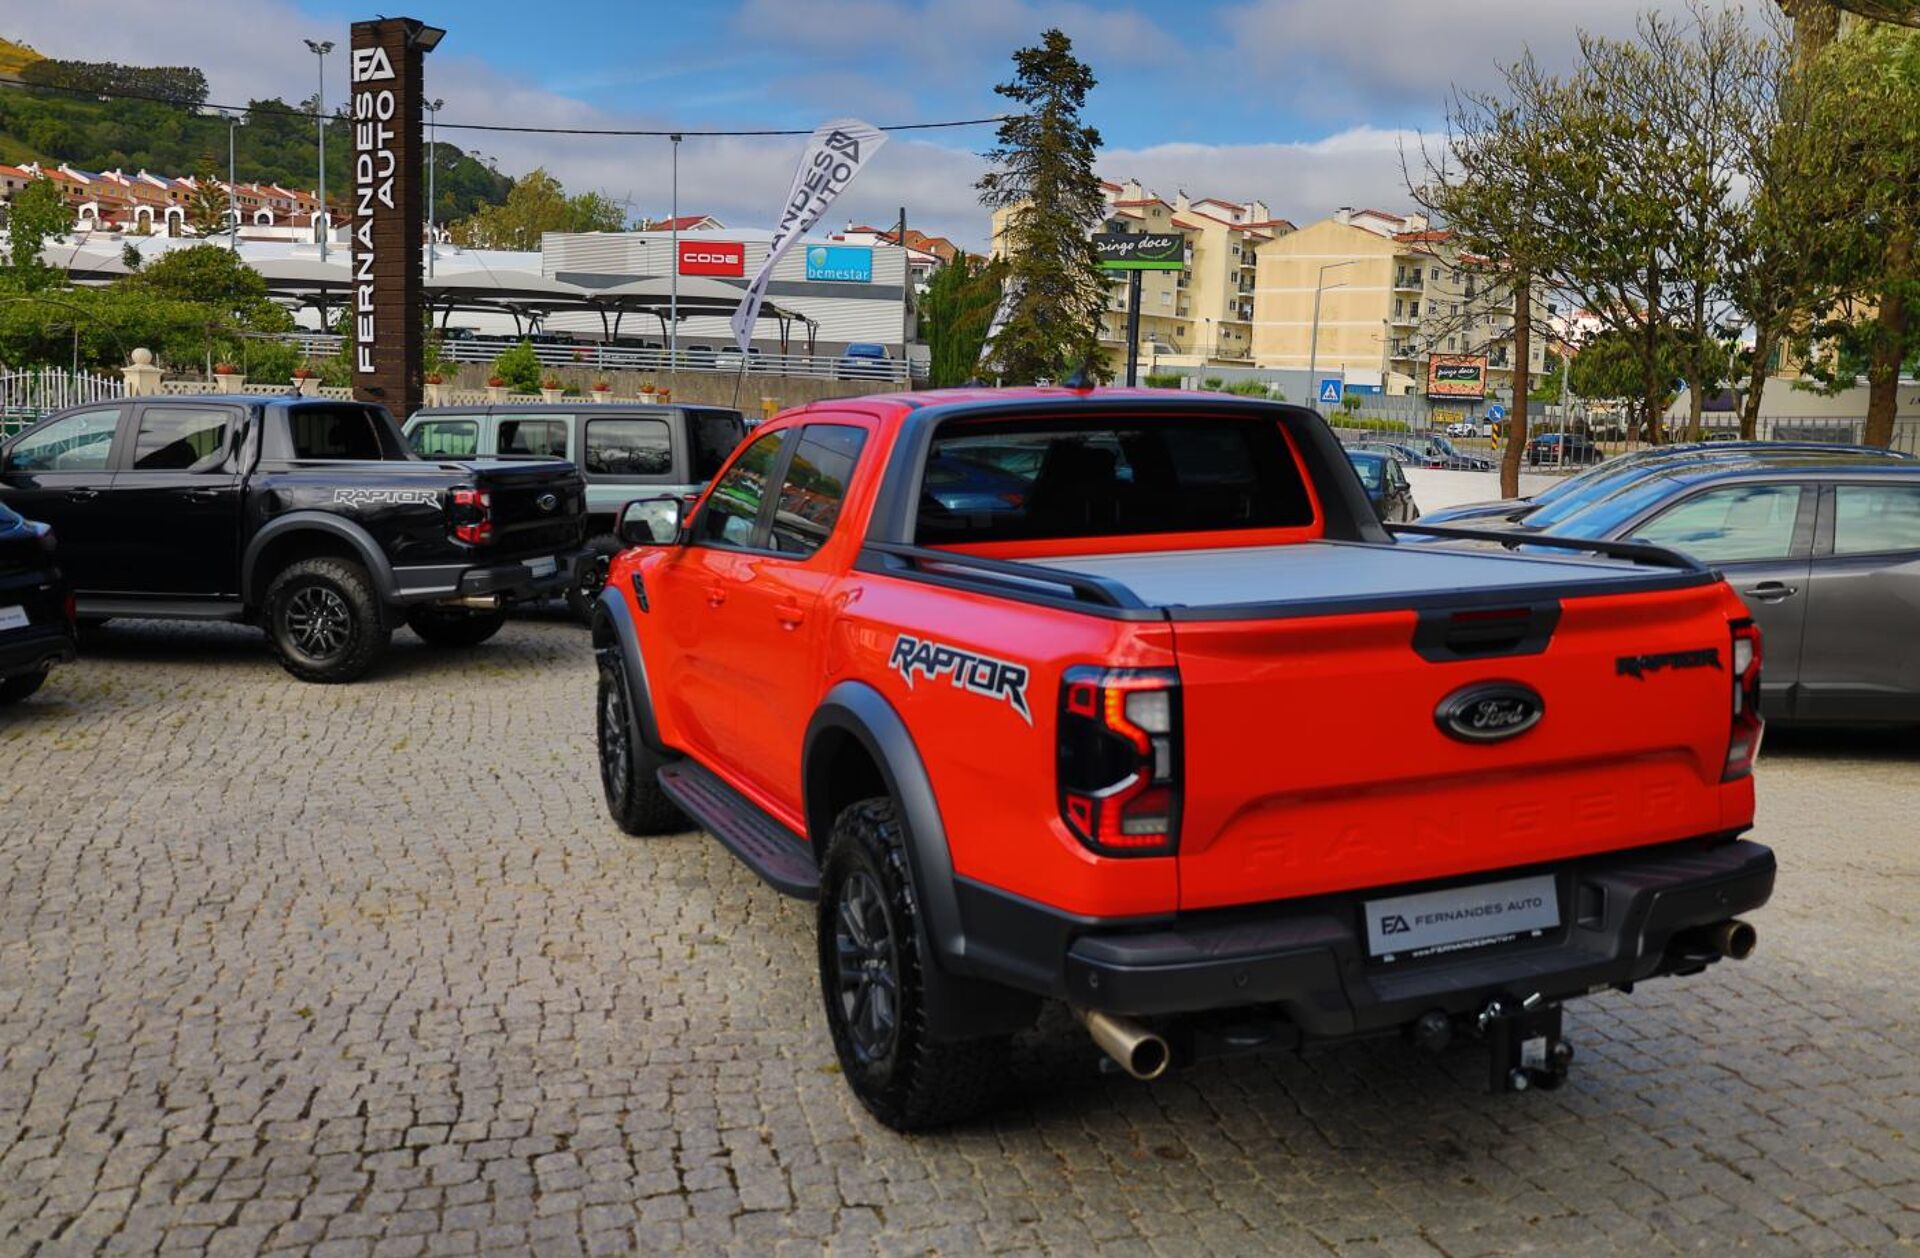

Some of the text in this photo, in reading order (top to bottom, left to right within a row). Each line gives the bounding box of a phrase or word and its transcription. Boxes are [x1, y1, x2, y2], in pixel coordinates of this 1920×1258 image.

[377, 90, 395, 209] AUTO
[356, 92, 375, 373] FERNANDES
[1138, 236, 1172, 249] doce
[683, 252, 739, 263] CODE
[808, 267, 869, 280] bemestar
[333, 489, 442, 510] RAPTOR
[889, 633, 1034, 728] RAPTOR
[1473, 701, 1523, 727] Ford
[1243, 778, 1687, 872] RANGER
[1415, 903, 1503, 926] FERNANDES
[1508, 897, 1543, 912] AUTO
